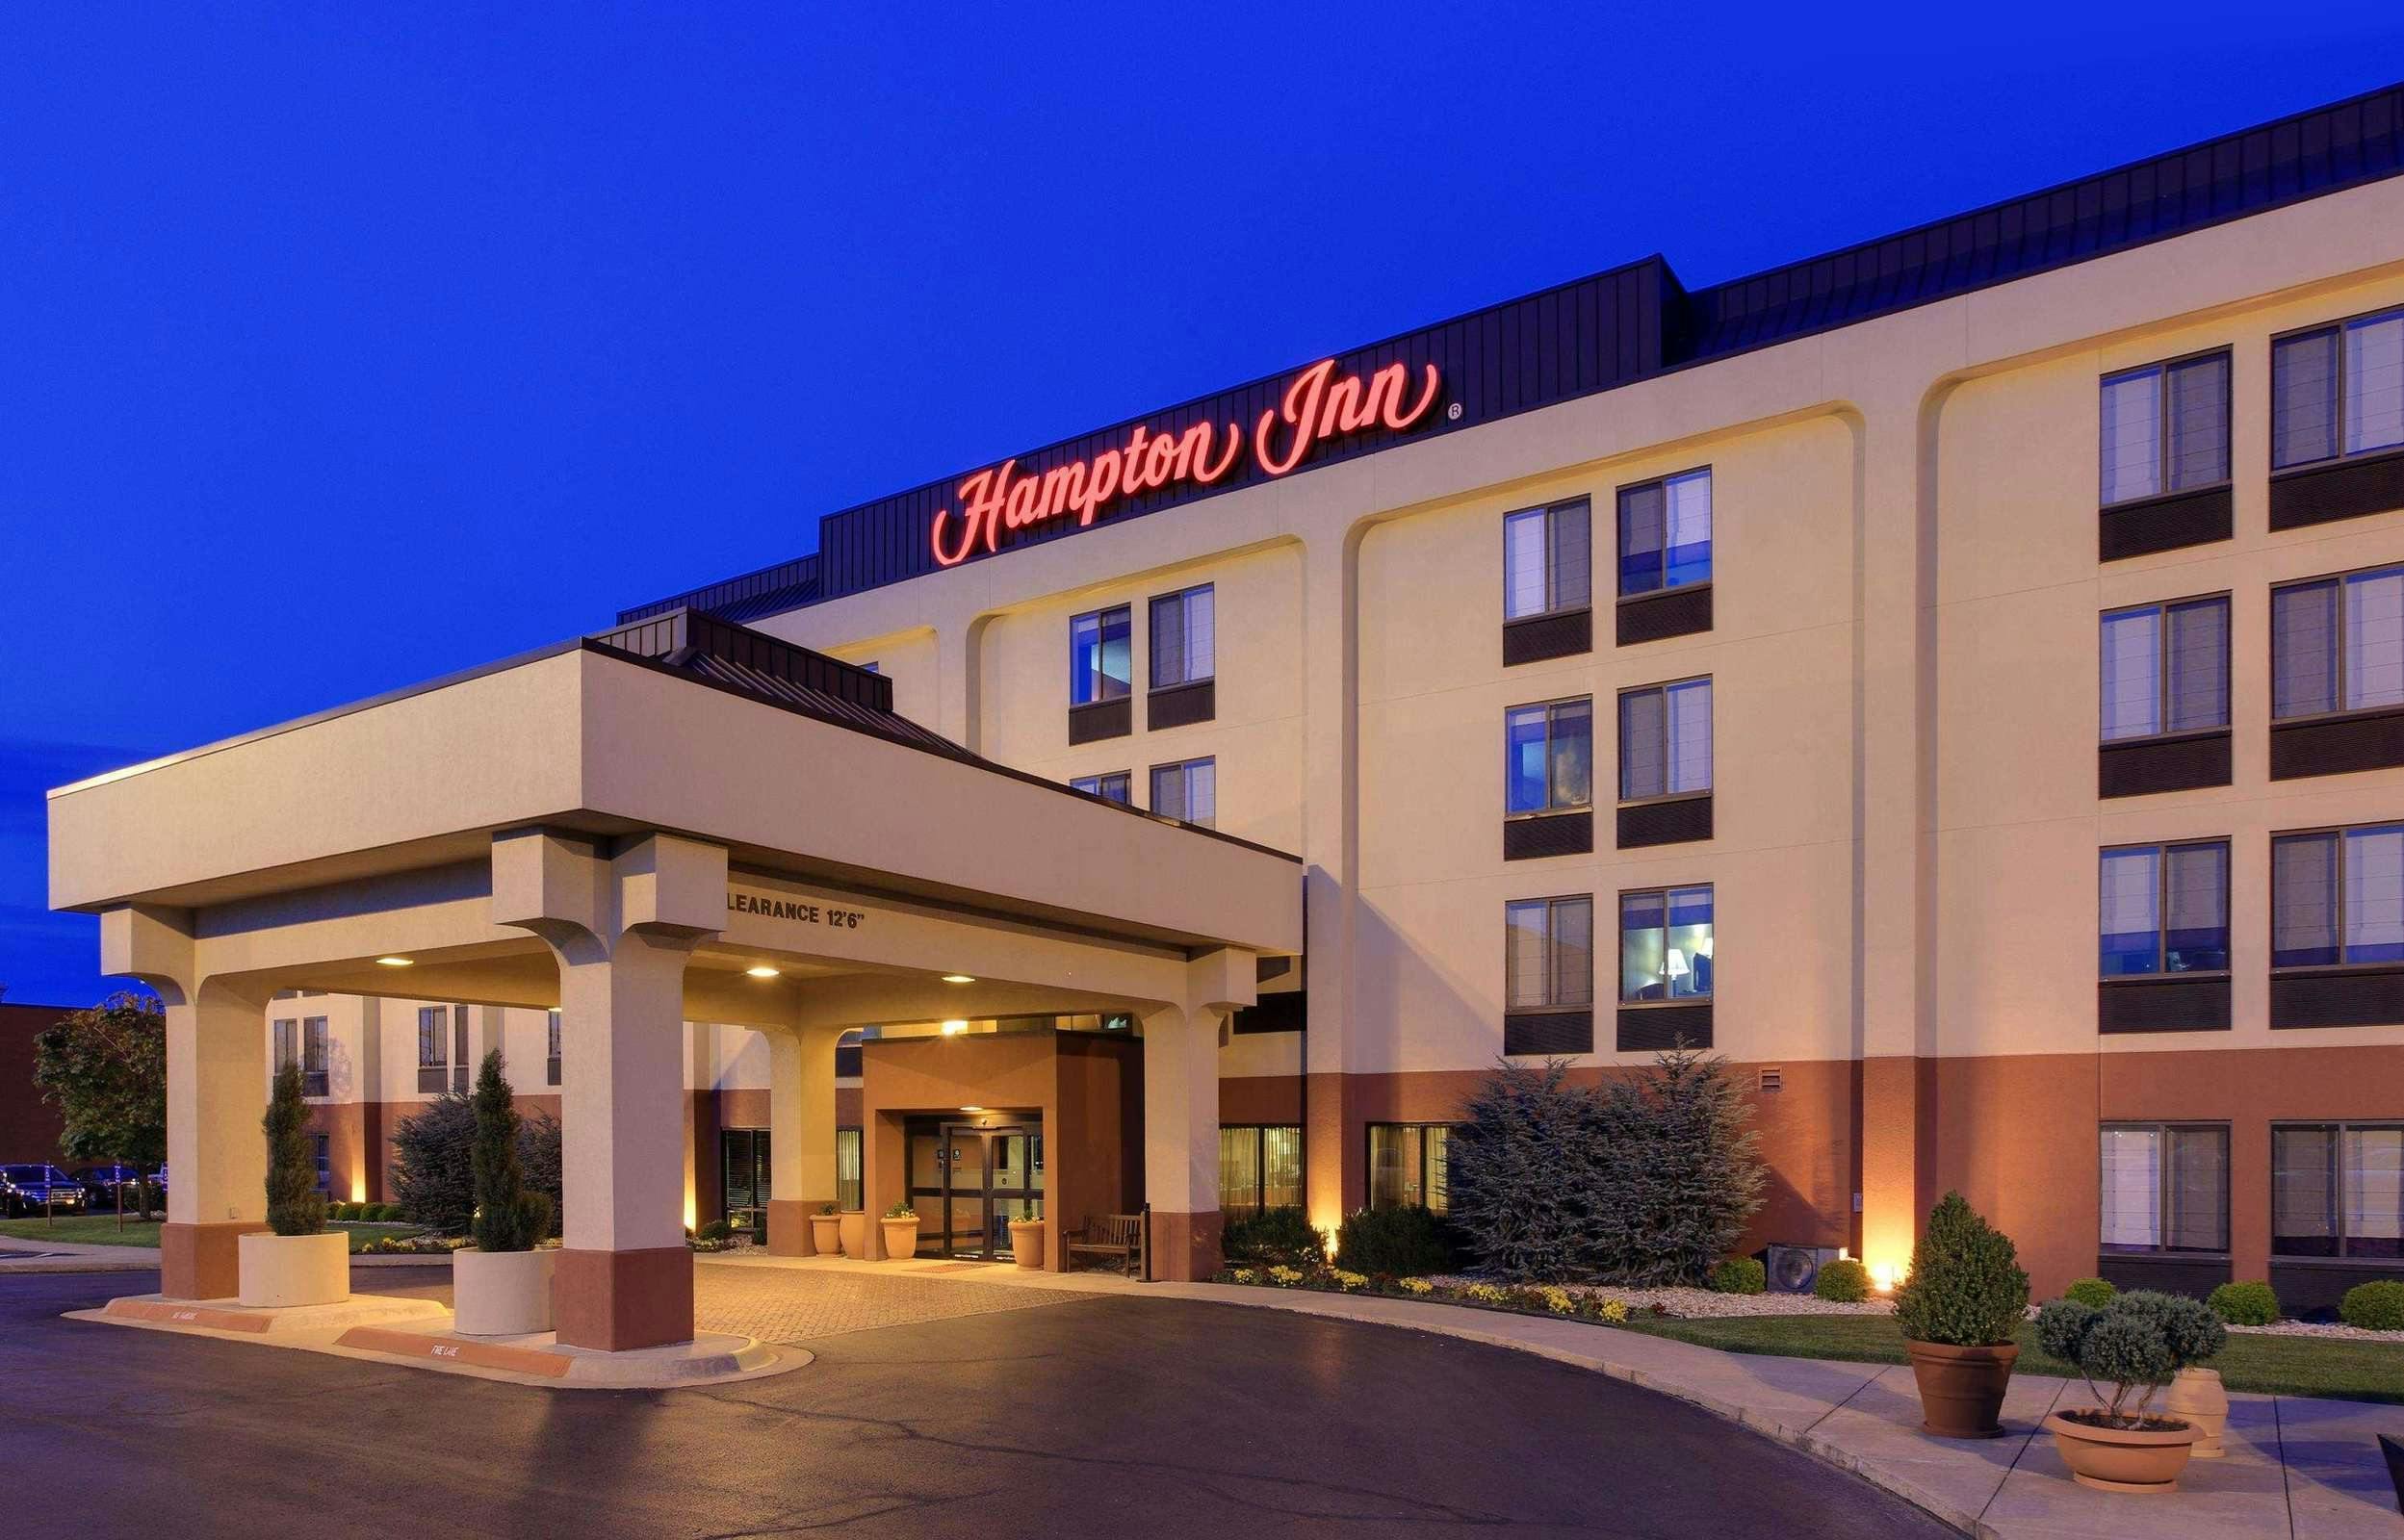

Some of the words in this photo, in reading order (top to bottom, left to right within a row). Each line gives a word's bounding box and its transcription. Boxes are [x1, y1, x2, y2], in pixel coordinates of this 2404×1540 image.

[932, 421, 1239, 566] Hampton
[1255, 359, 1438, 475] Inn
[727, 892, 819, 923] LEARANCE
